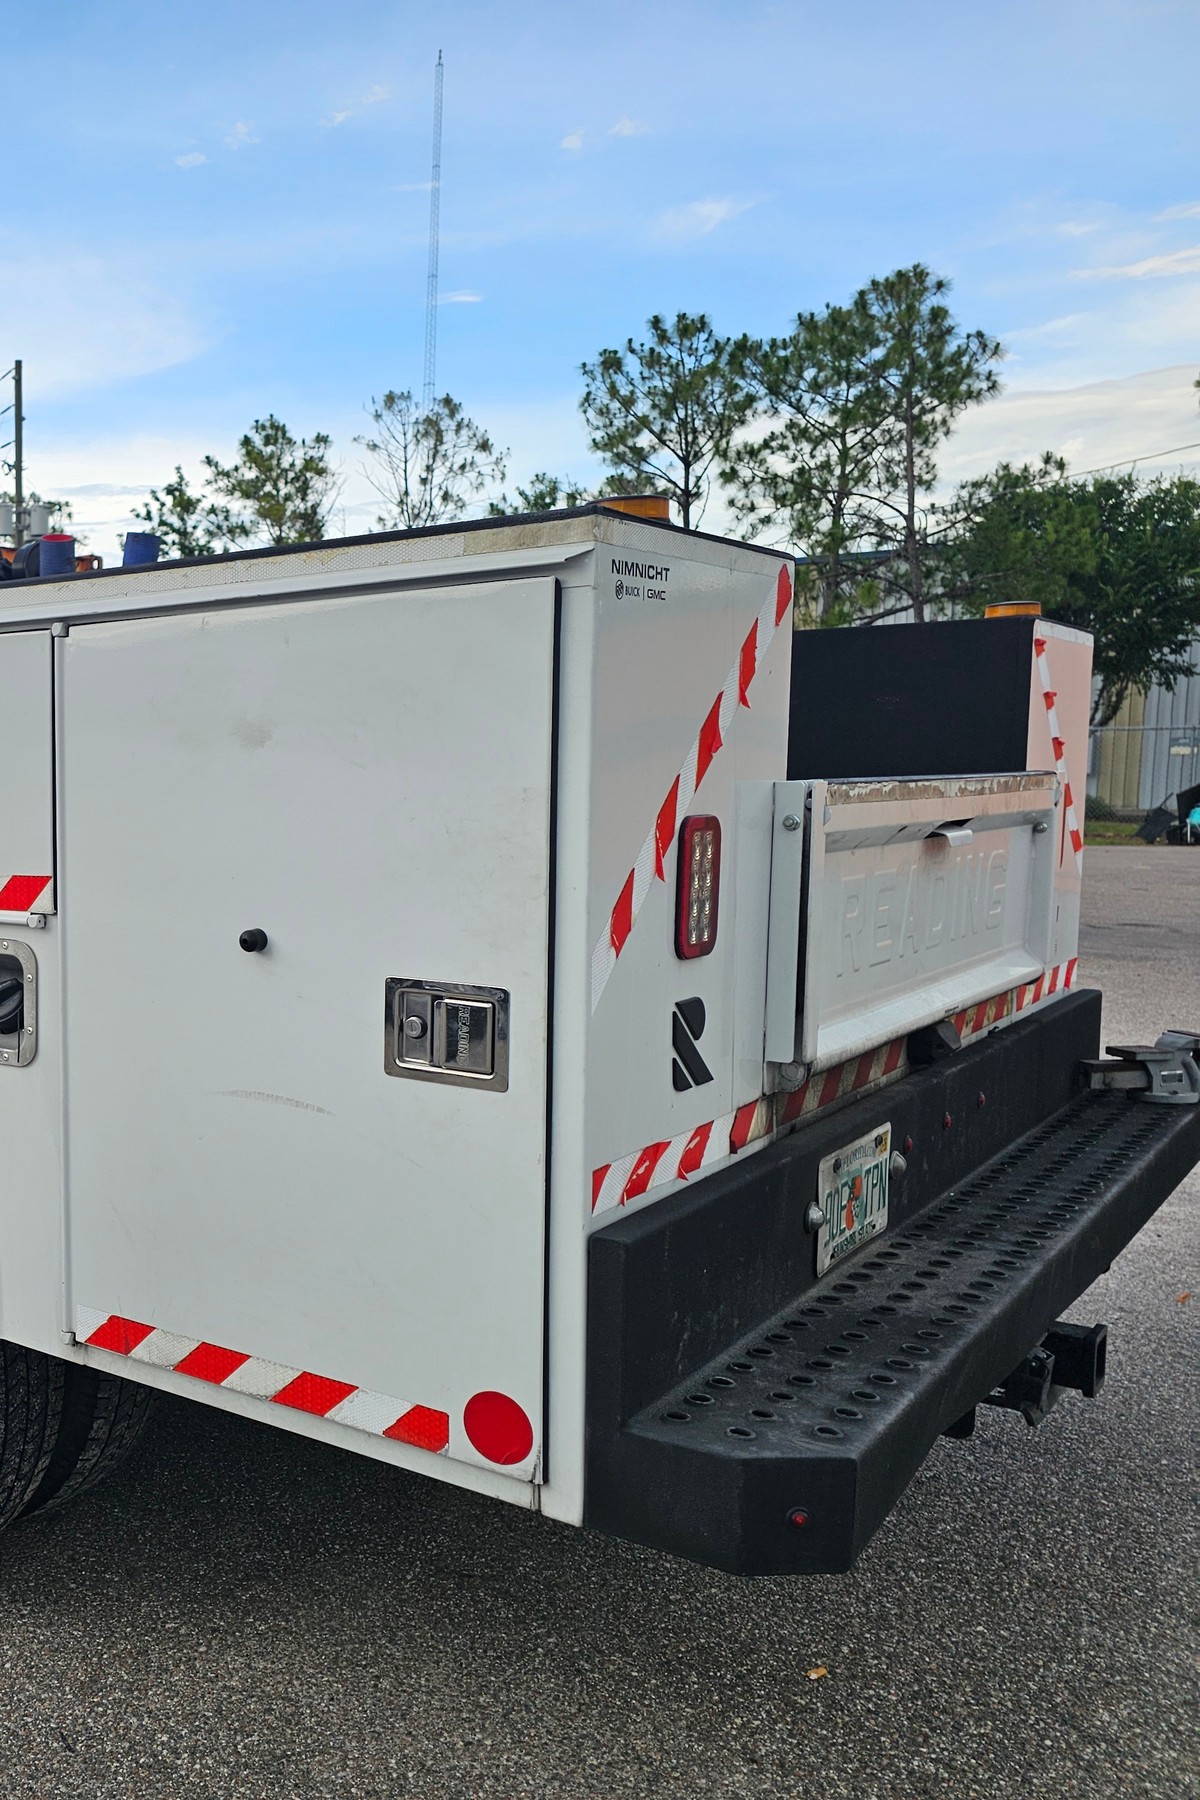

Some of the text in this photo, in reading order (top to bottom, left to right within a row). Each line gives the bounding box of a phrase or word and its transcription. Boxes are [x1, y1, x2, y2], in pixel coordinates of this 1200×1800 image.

[611, 558, 670, 582] NIMNICHT
[625, 585, 666, 601] BUICK GMC
[835, 849, 1008, 978] READING
[458, 1005, 471, 1066] READING
[863, 1157, 888, 1220] TPN
